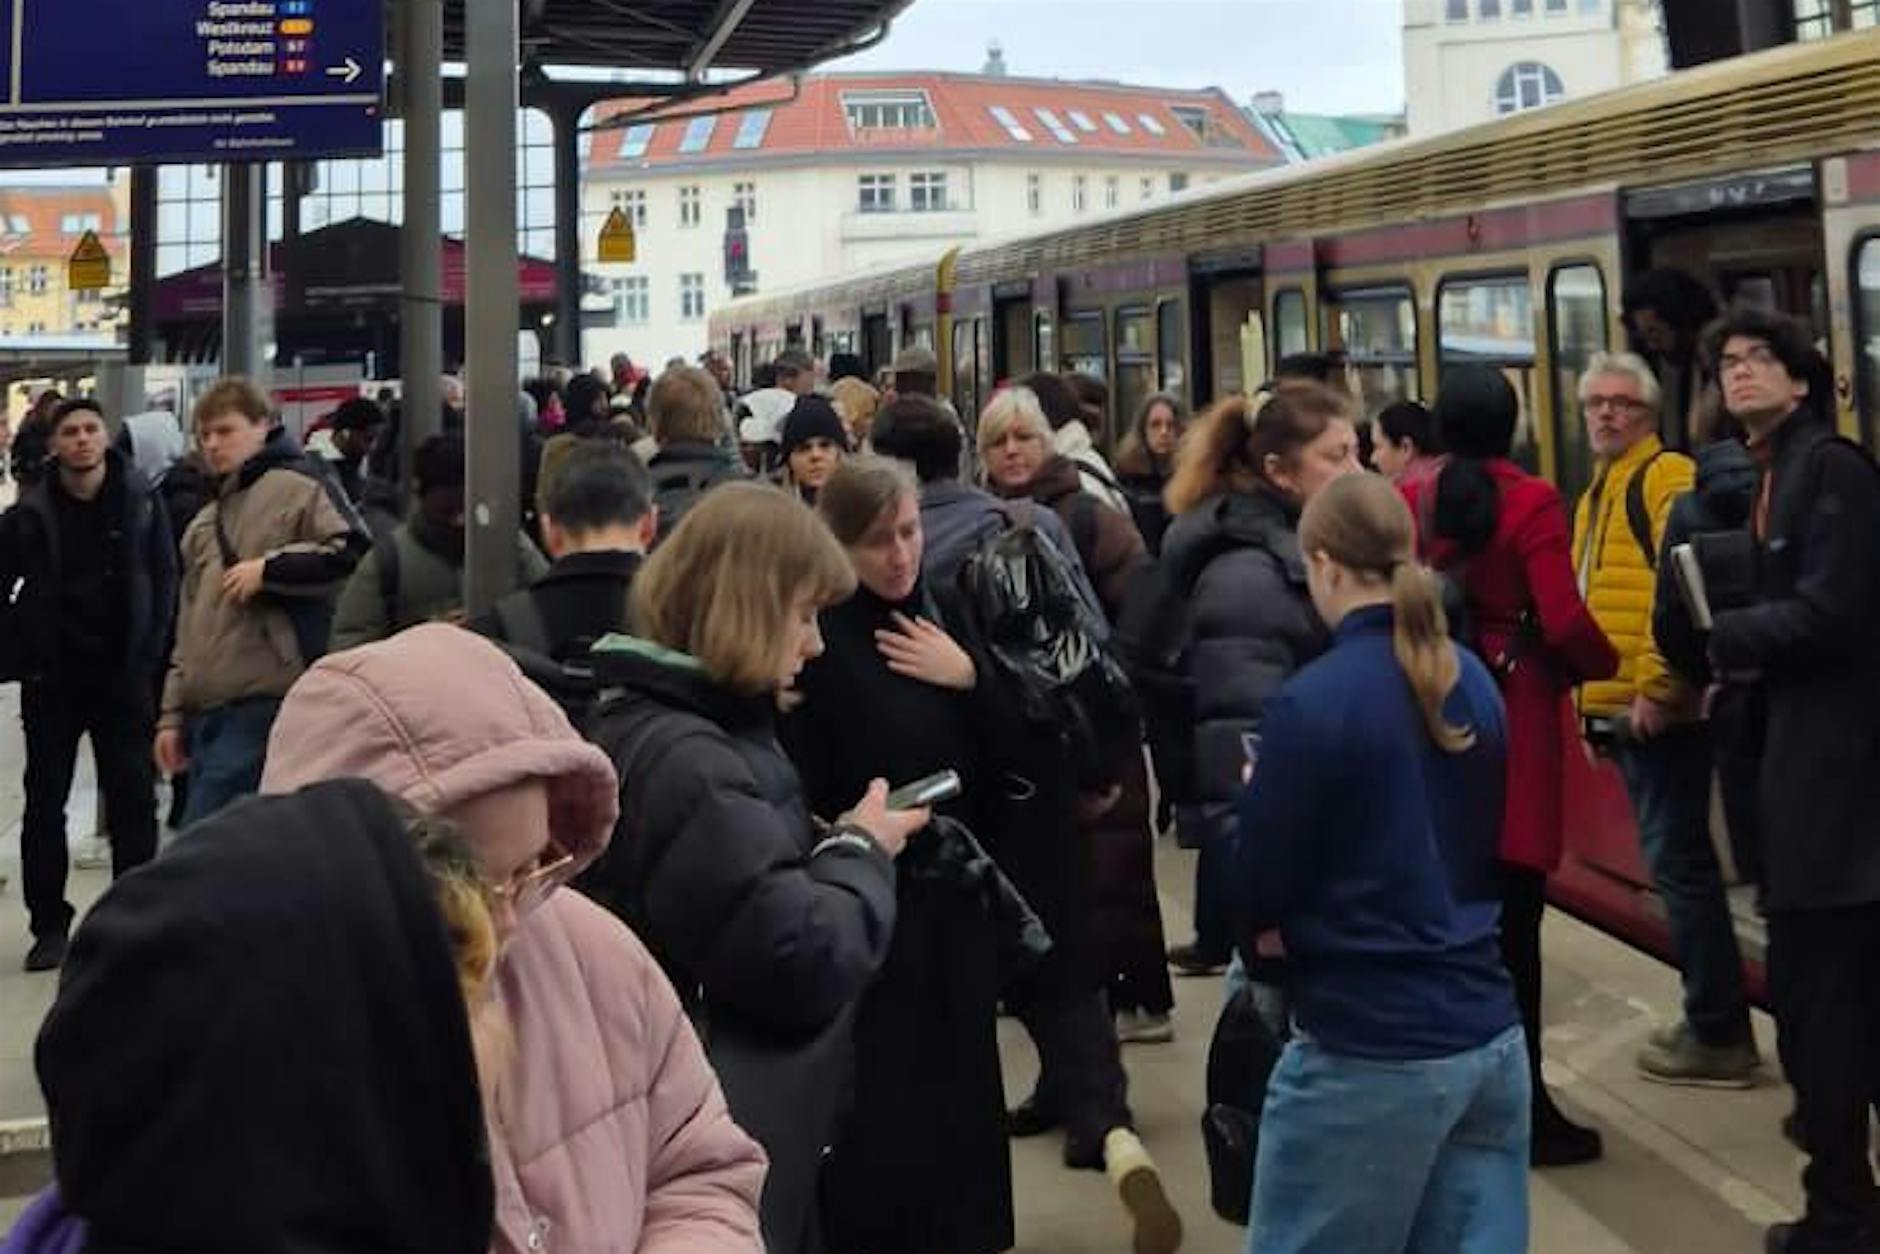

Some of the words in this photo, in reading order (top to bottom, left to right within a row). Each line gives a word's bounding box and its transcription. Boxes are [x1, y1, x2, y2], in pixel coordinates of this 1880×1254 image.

[208, 1, 276, 17] Spandau
[196, 21, 274, 36] Westkreuz
[207, 40, 276, 56] Potsdam
[207, 60, 276, 77] Spandau
